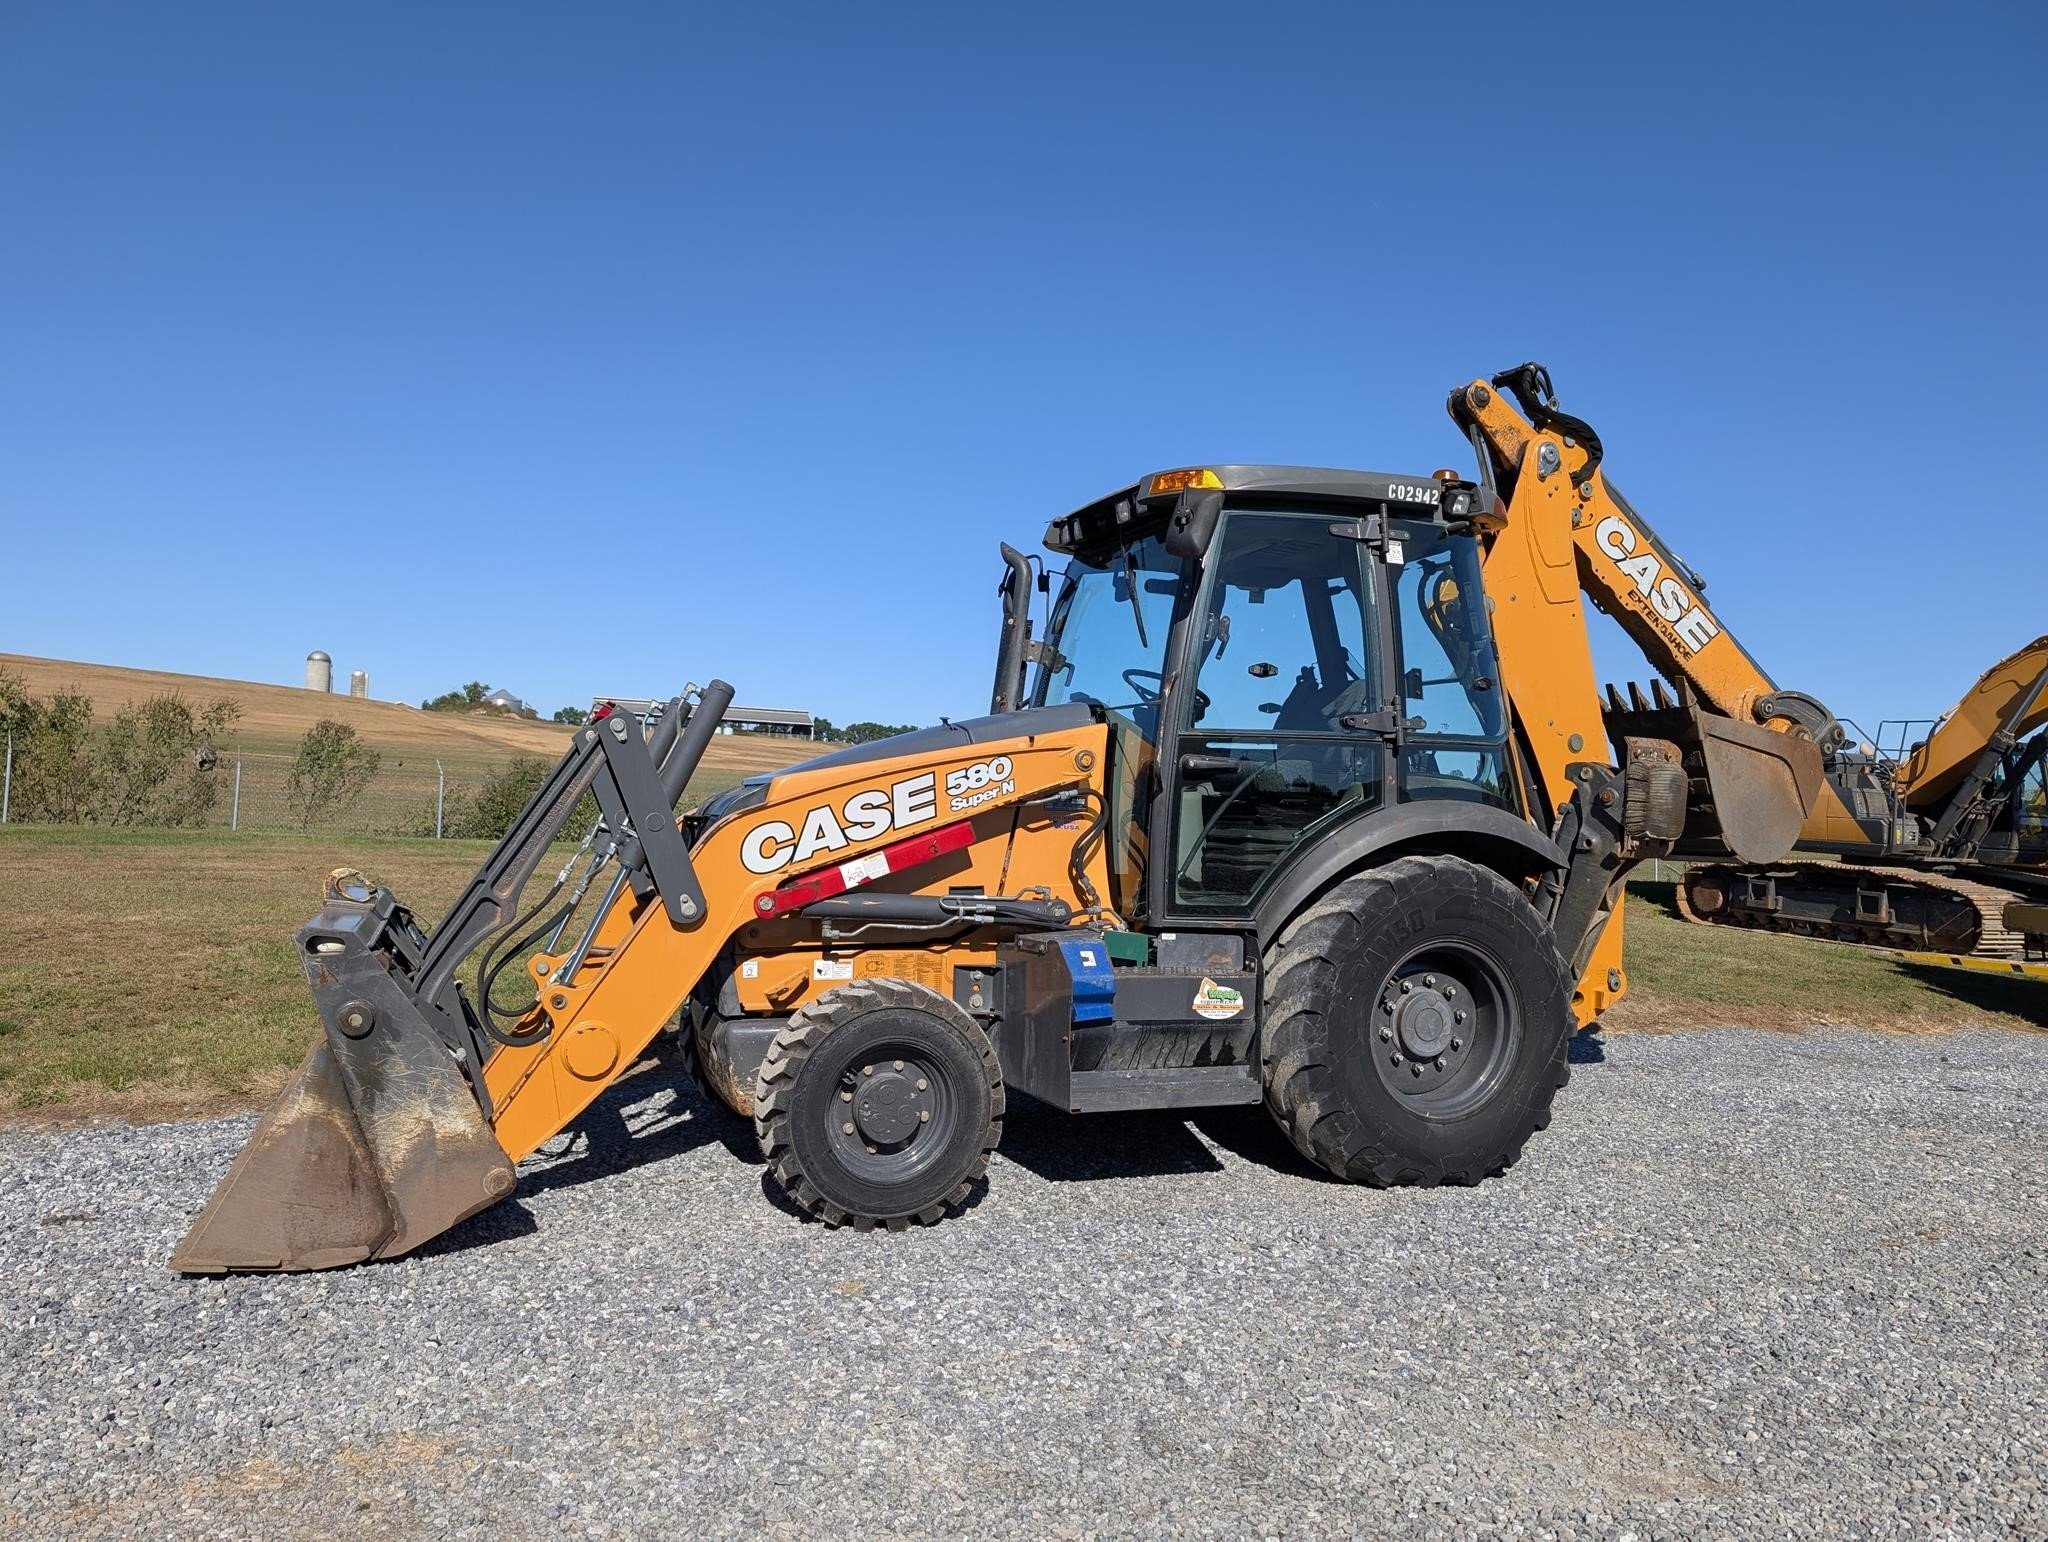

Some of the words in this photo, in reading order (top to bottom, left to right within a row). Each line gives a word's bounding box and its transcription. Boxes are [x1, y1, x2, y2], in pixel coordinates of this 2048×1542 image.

[1595, 516, 1721, 655] CASE
[945, 755, 1013, 796] 580
[950, 786, 1000, 812] Super
[1001, 778, 1015, 796] N
[740, 771, 937, 874] CASE
